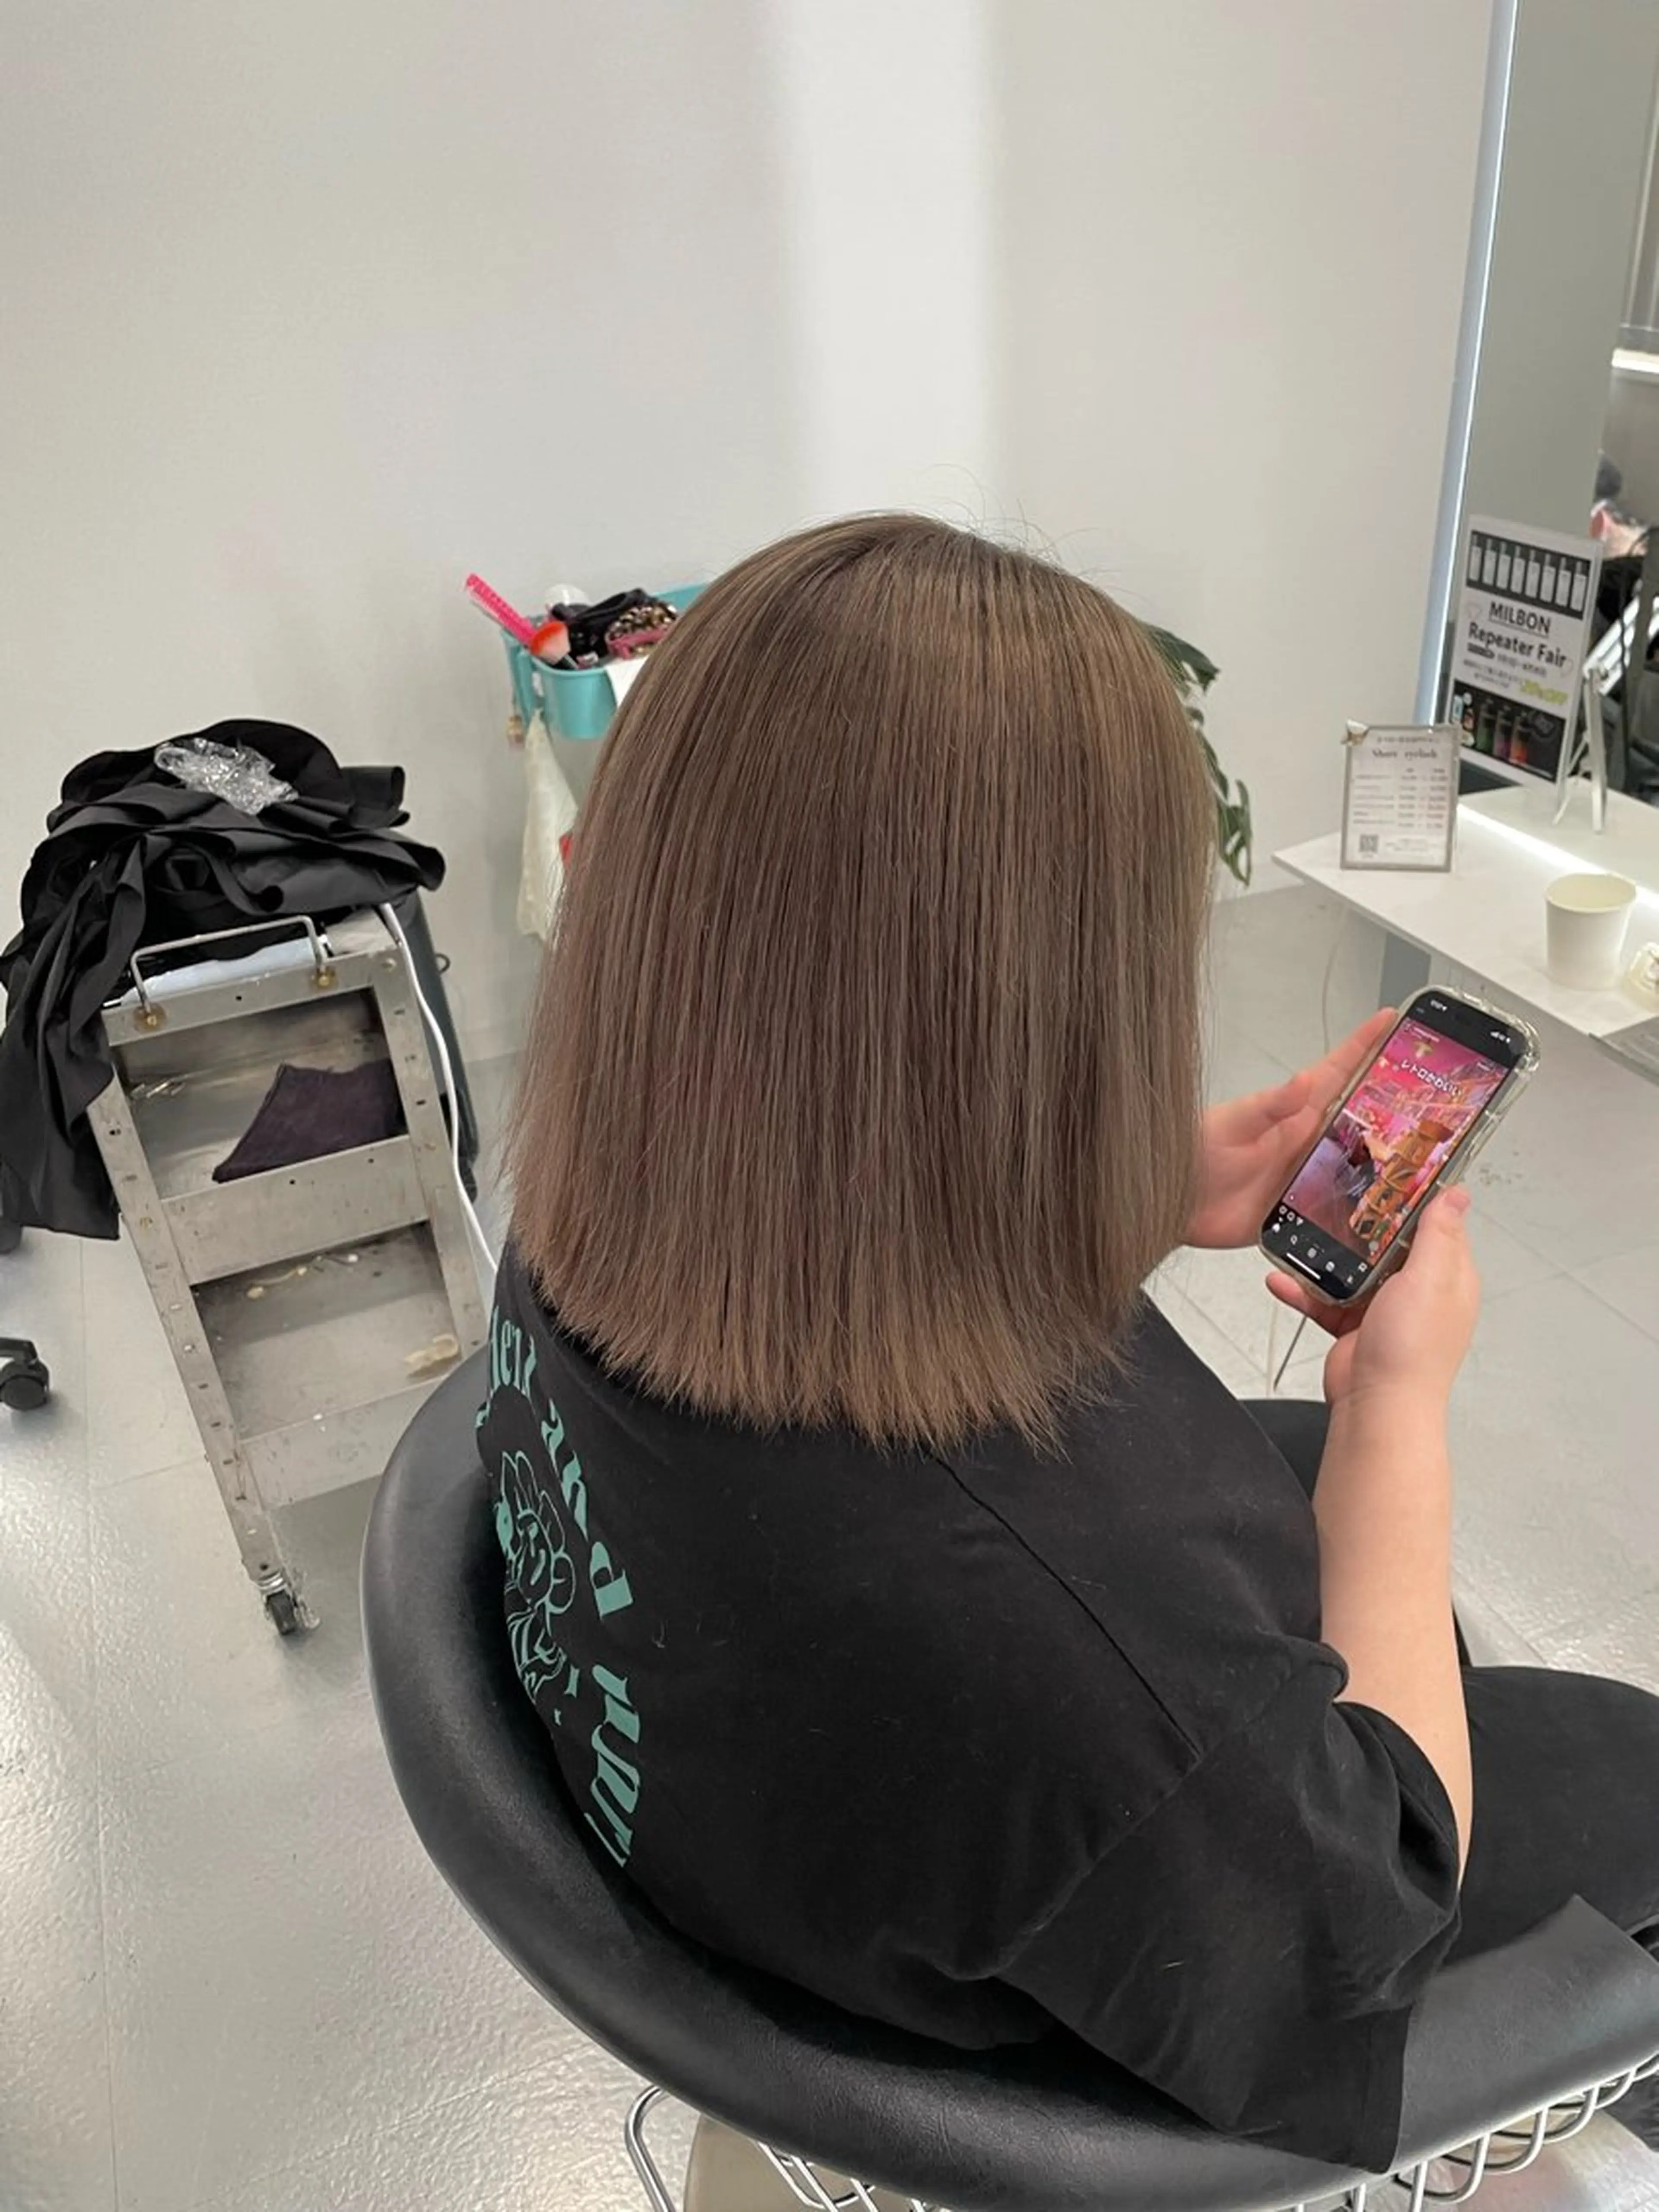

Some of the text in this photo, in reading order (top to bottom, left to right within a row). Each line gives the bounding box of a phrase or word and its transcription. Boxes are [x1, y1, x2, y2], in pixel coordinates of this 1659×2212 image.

[1490, 601, 1551, 634] MILBON
[1468, 621, 1535, 658] Repeater
[1537, 643, 1567, 668] Fair
[1401, 1059, 1462, 1096] レトロかわいい
